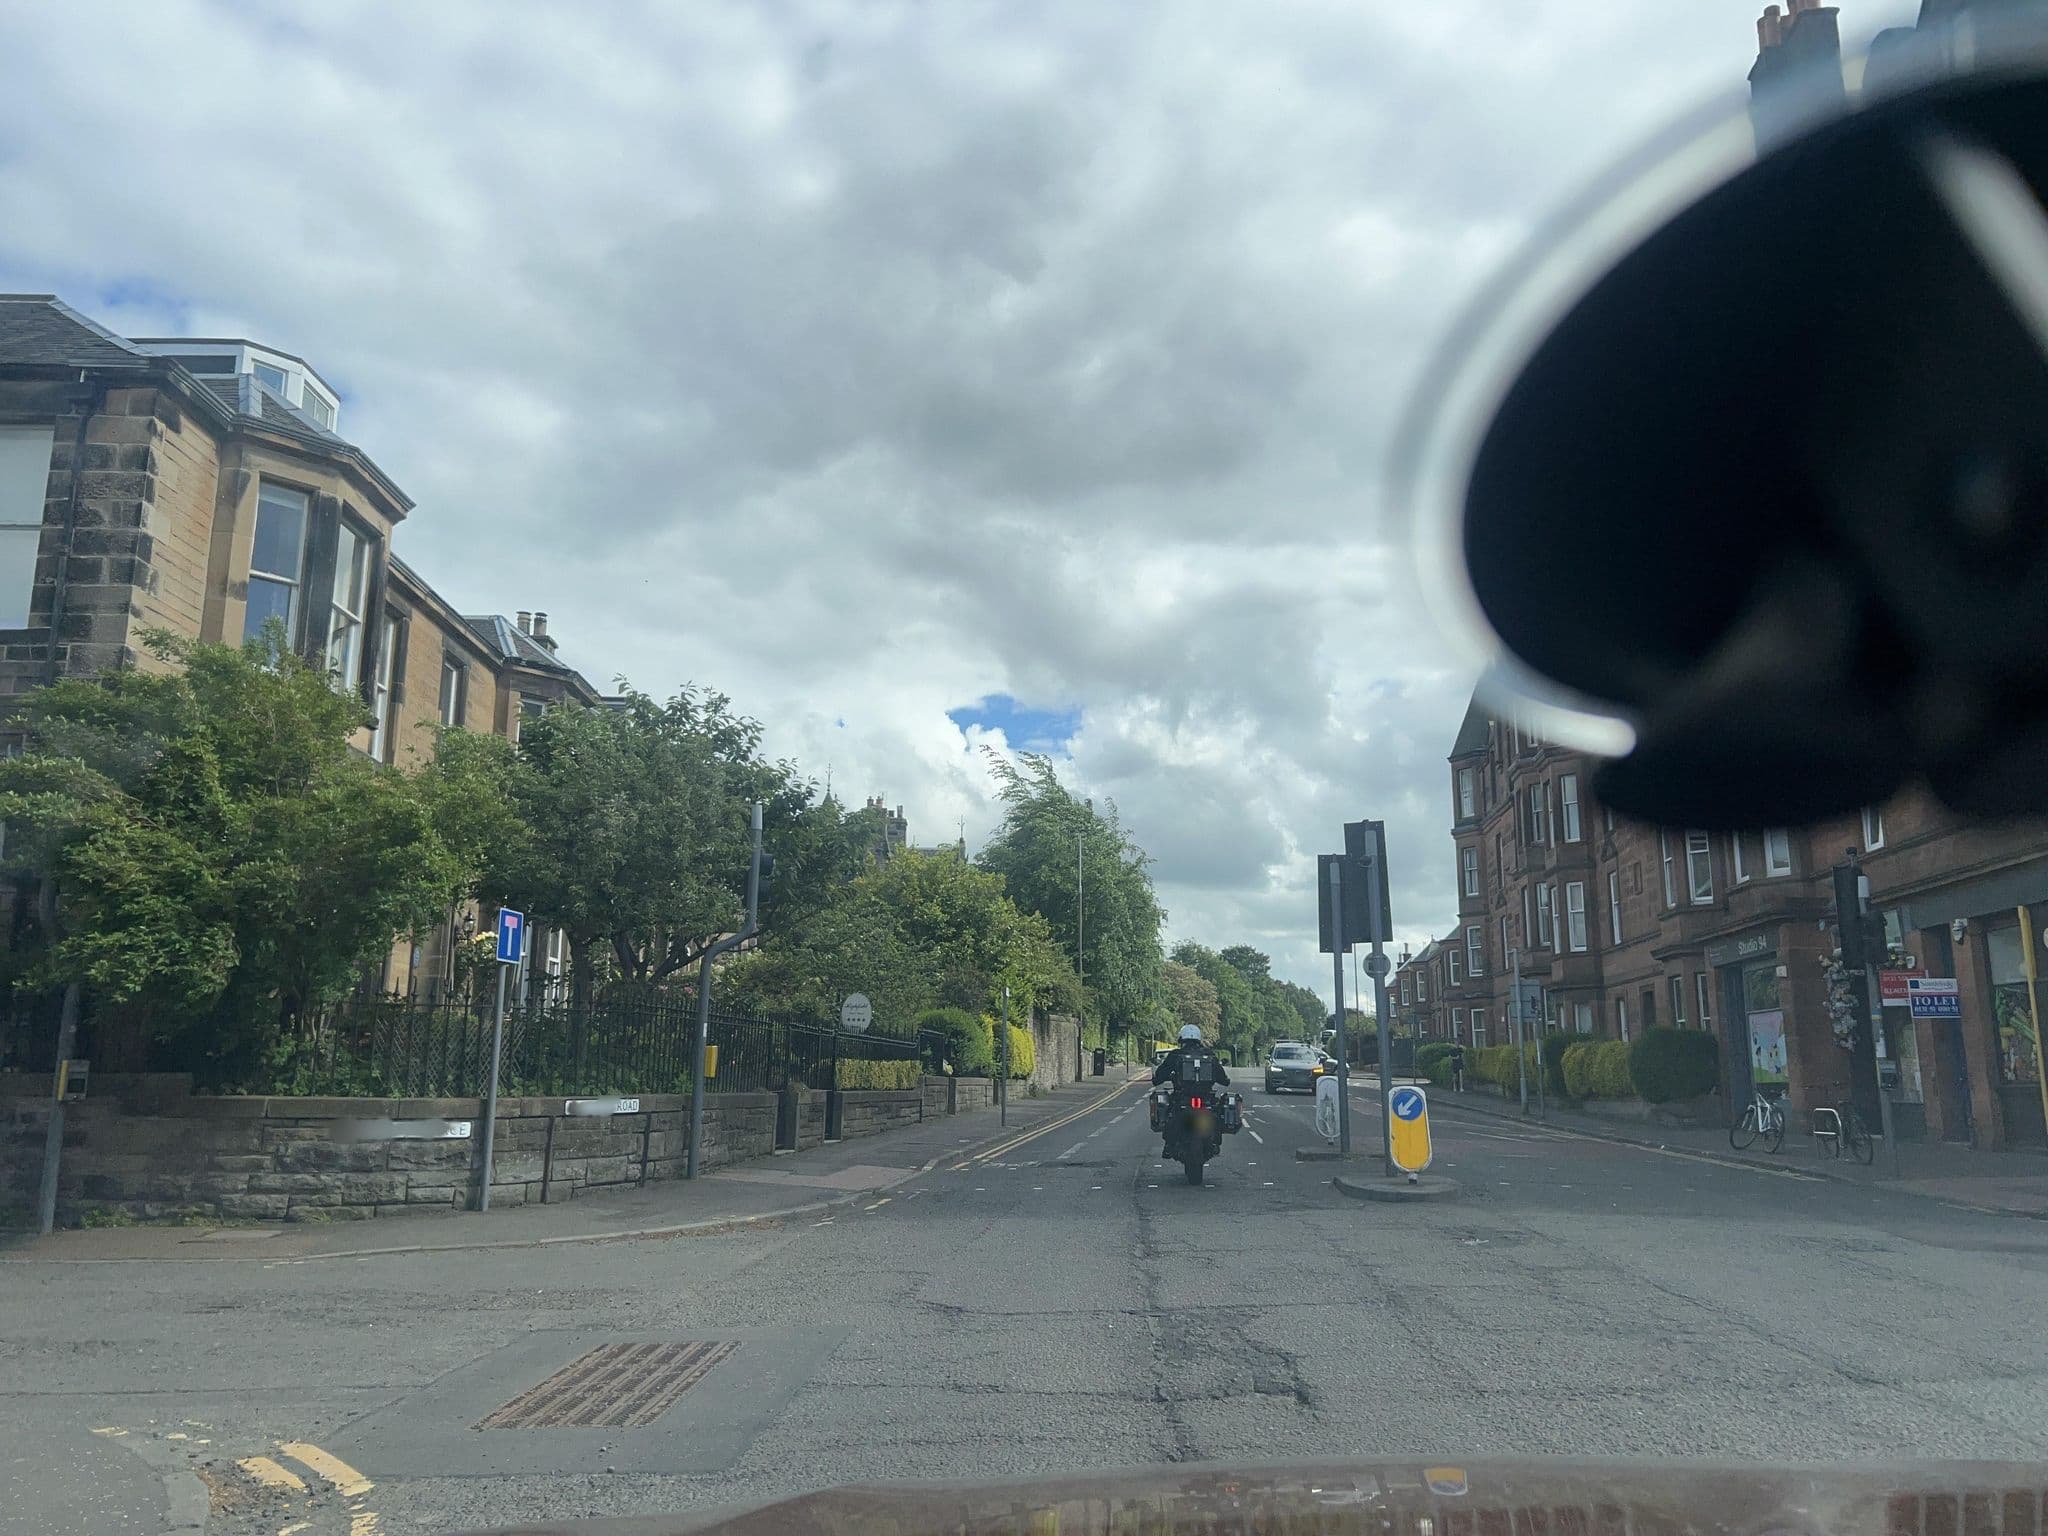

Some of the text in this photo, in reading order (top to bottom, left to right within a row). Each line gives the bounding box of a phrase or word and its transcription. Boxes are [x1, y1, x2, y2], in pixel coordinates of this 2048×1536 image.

[1738, 938, 1757, 955] Studio
[1913, 996, 1931, 1006] TO
[1934, 996, 1958, 1006] LET
[616, 1100, 638, 1111] ROAD
